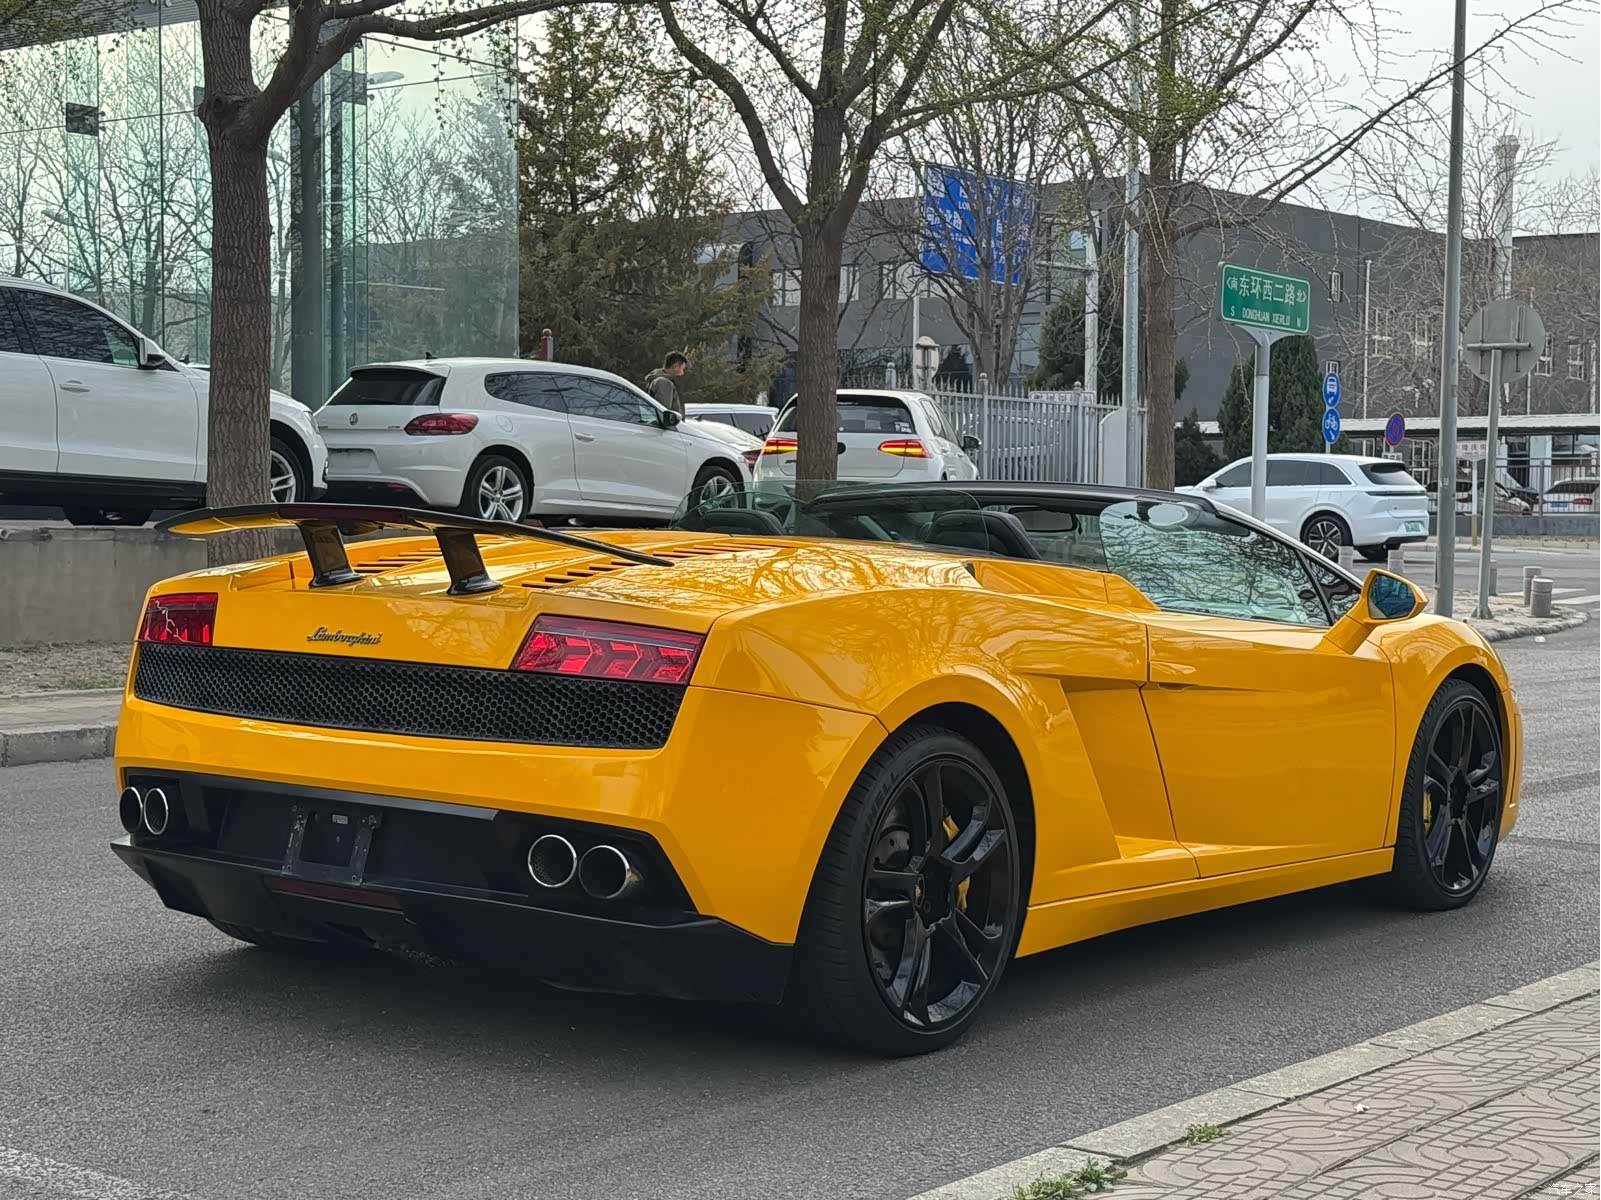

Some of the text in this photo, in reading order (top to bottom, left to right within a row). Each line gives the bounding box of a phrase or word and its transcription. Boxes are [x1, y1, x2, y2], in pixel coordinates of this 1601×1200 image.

[1239, 274, 1295, 305] 东环西二路
[1230, 305, 1302, 328] S DONGHUAN XIERLU N
[306, 626, 383, 647] Lamborghini
